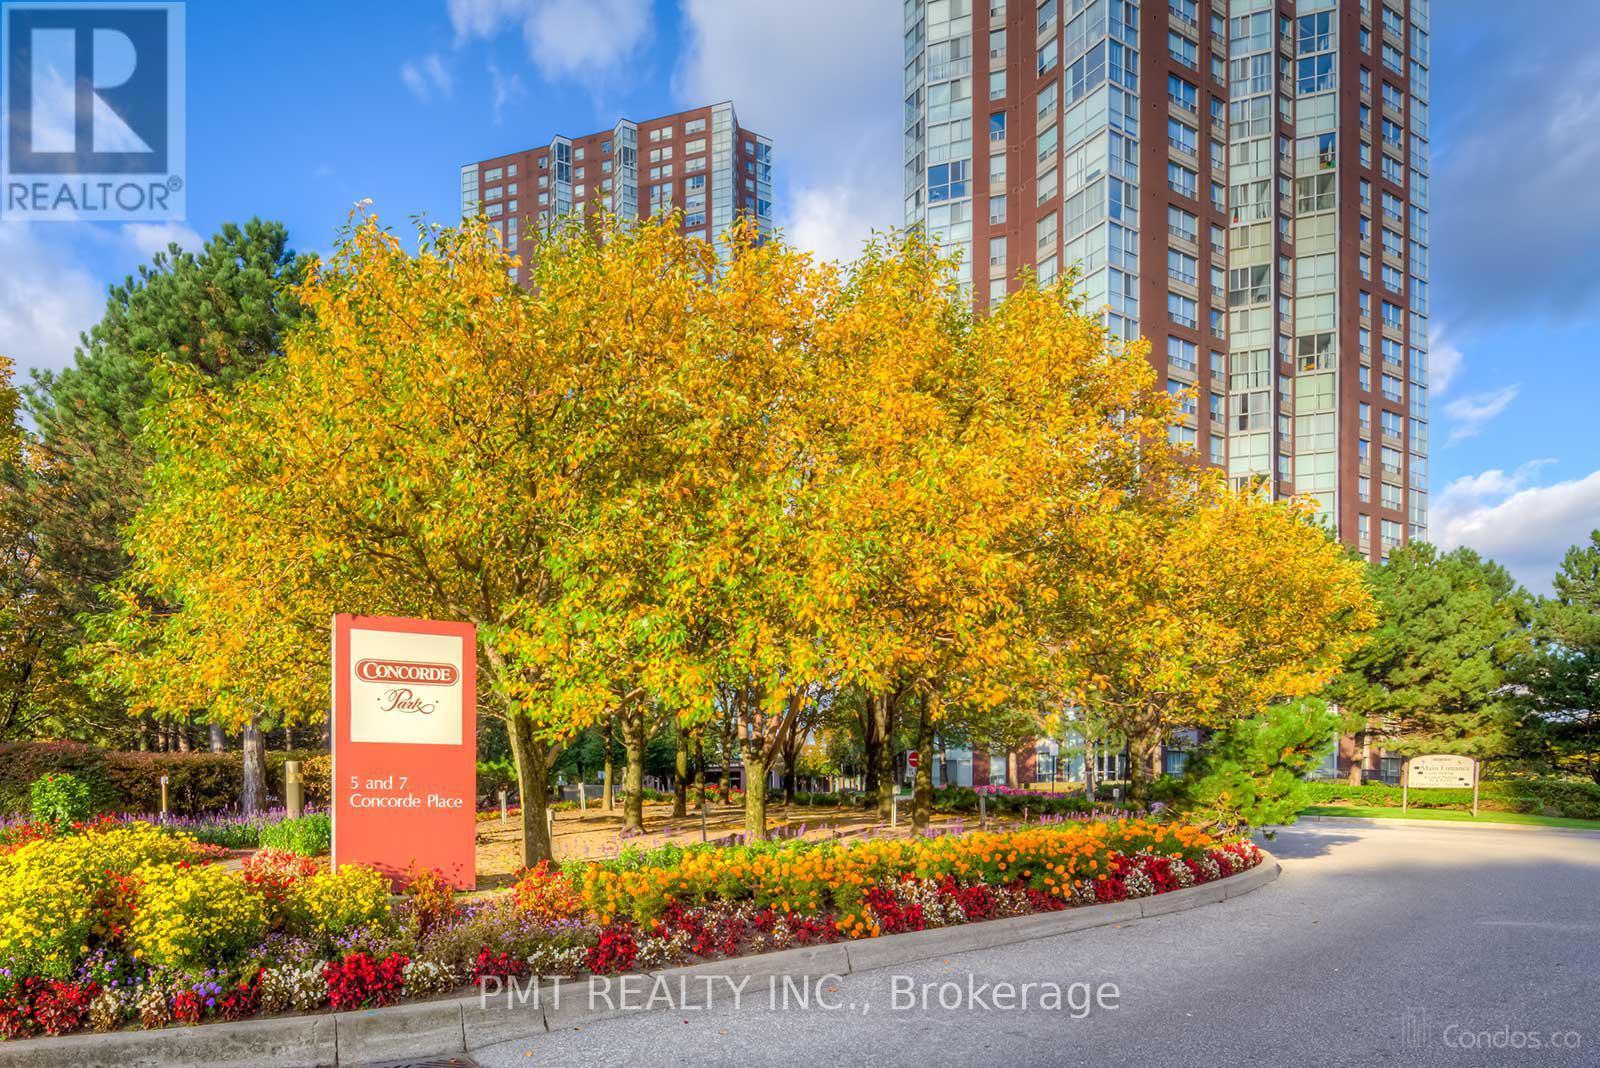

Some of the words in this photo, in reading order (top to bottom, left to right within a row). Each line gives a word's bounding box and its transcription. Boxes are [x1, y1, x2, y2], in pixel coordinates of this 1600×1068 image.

[363, 662, 450, 681] CONCORDE
[380, 688, 436, 715] Park
[350, 777, 359, 790] 5
[365, 776, 393, 790] and
[399, 777, 408, 791] 7
[350, 794, 421, 808] Concorde
[427, 795, 463, 808] Place
